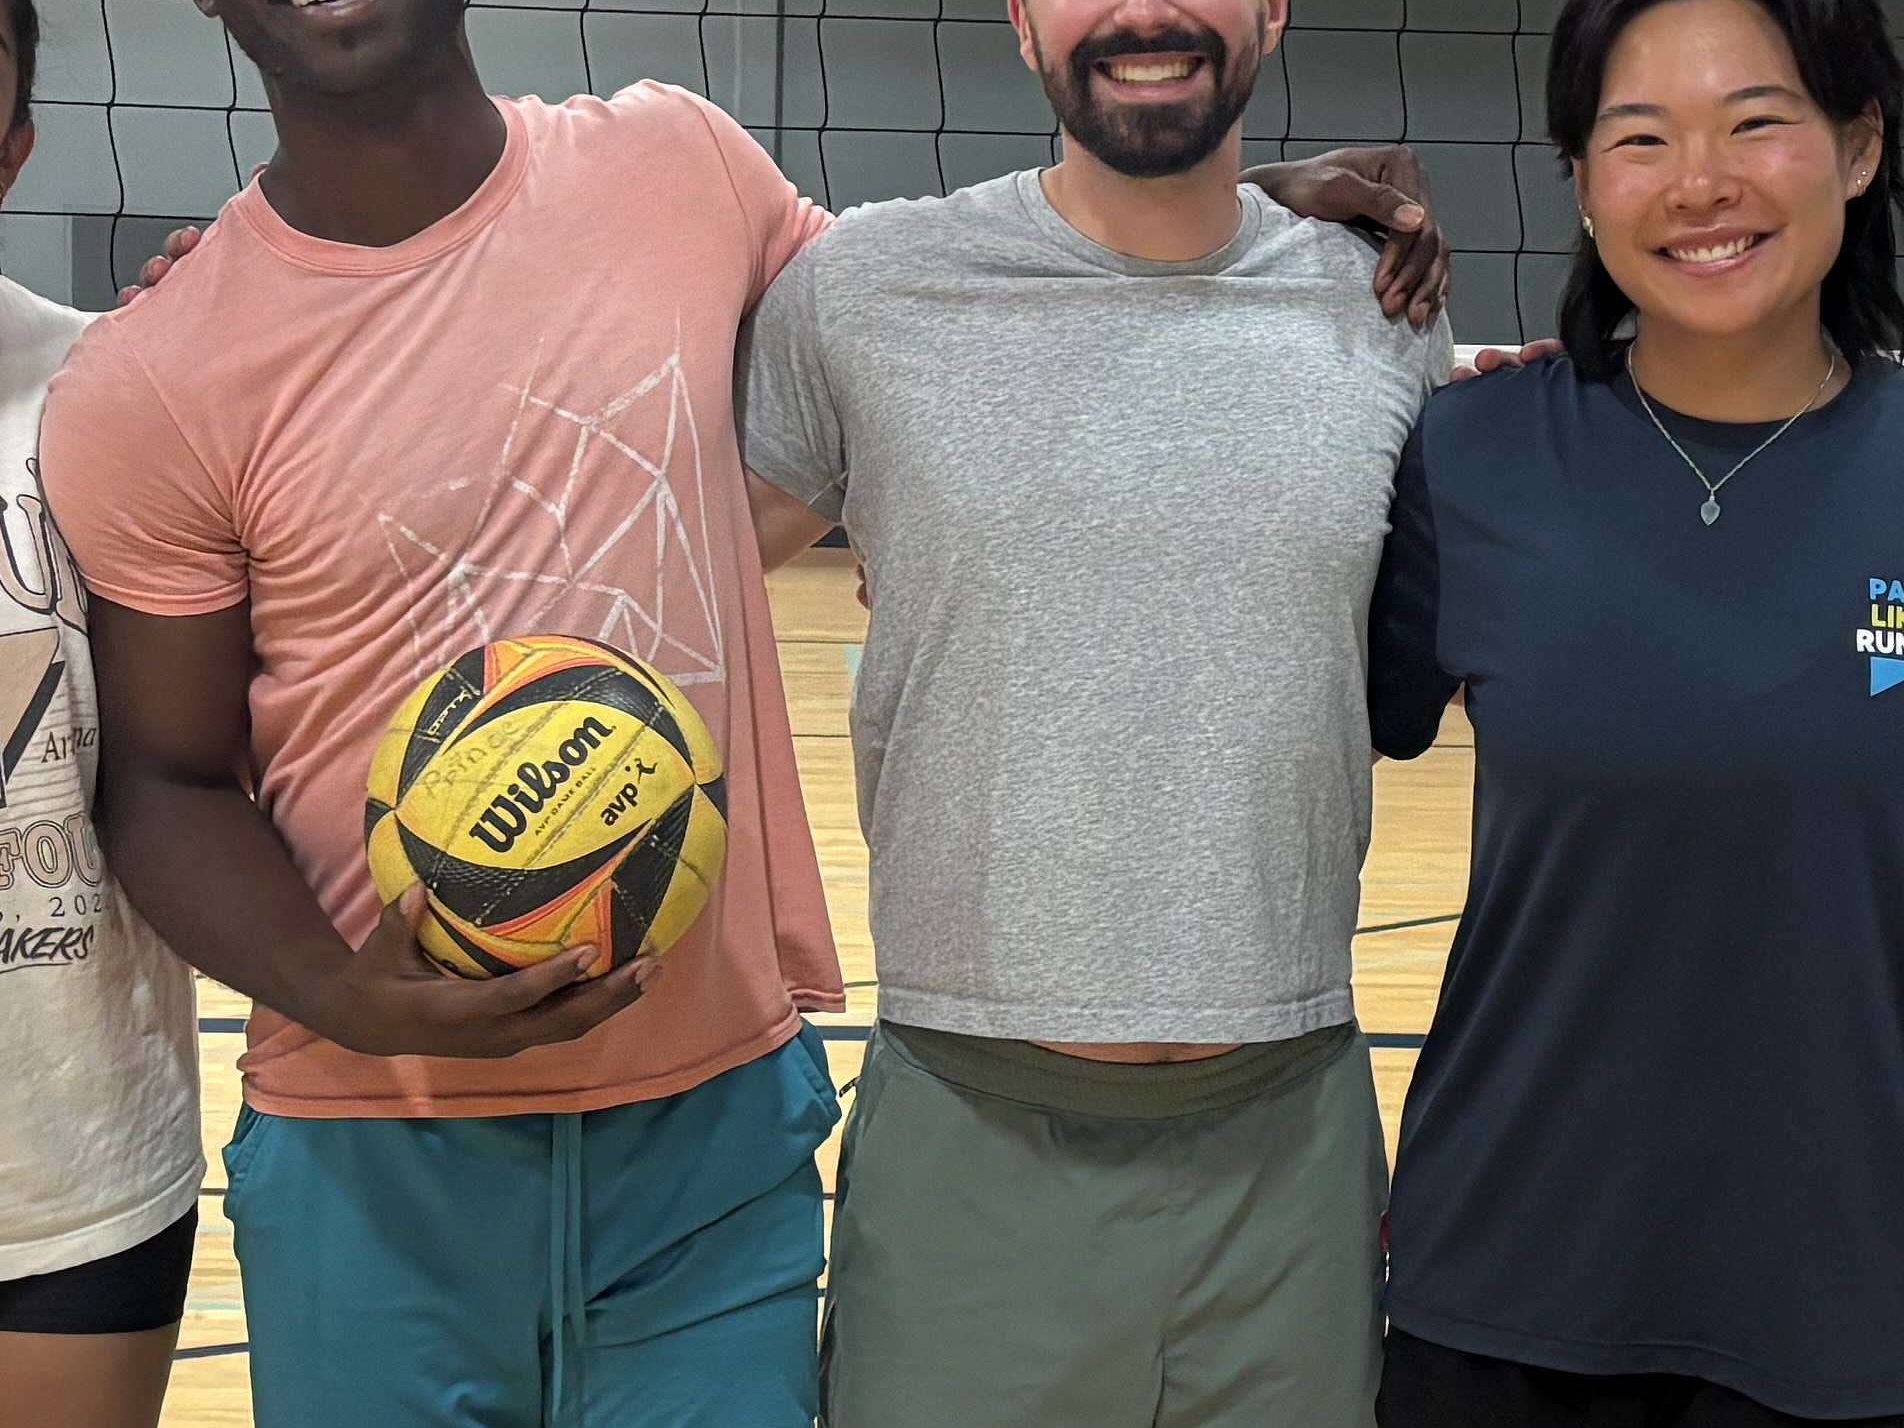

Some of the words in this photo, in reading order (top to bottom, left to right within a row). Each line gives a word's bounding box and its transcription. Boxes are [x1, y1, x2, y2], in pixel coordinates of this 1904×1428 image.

[469, 716, 614, 853] Wilson
[600, 783, 638, 826] avp
[49, 893, 103, 918] 202
